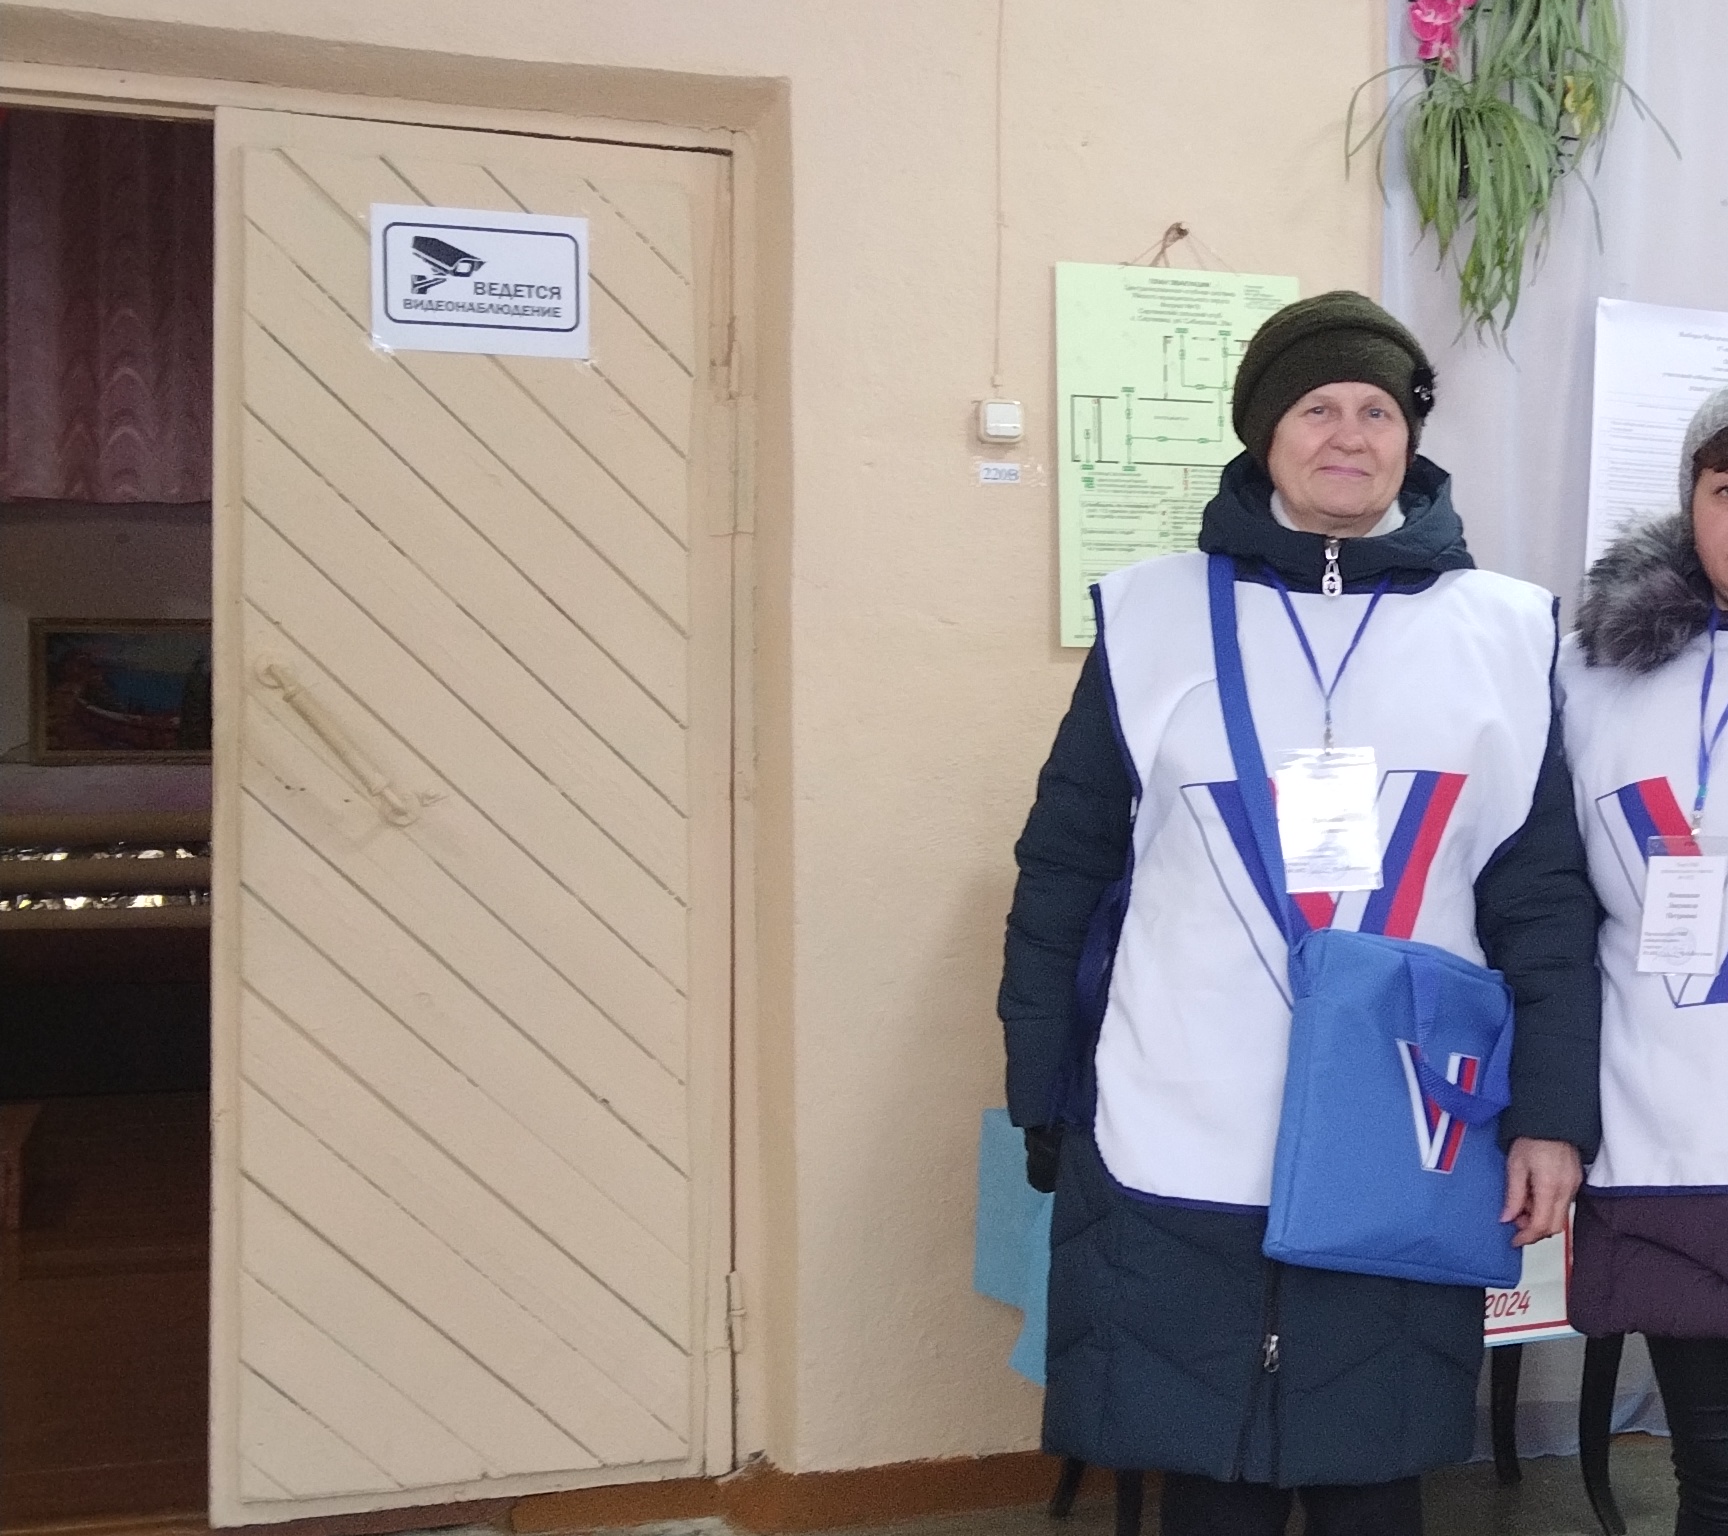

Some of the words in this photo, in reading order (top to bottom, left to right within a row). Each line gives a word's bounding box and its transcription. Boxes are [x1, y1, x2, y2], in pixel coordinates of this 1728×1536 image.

[473, 281, 562, 300] ВЕДЕТСЯ
[402, 298, 562, 318] ВИДЕОНАБЛЮДЕНИЕ
[1484, 1289, 1532, 1319] 2024
